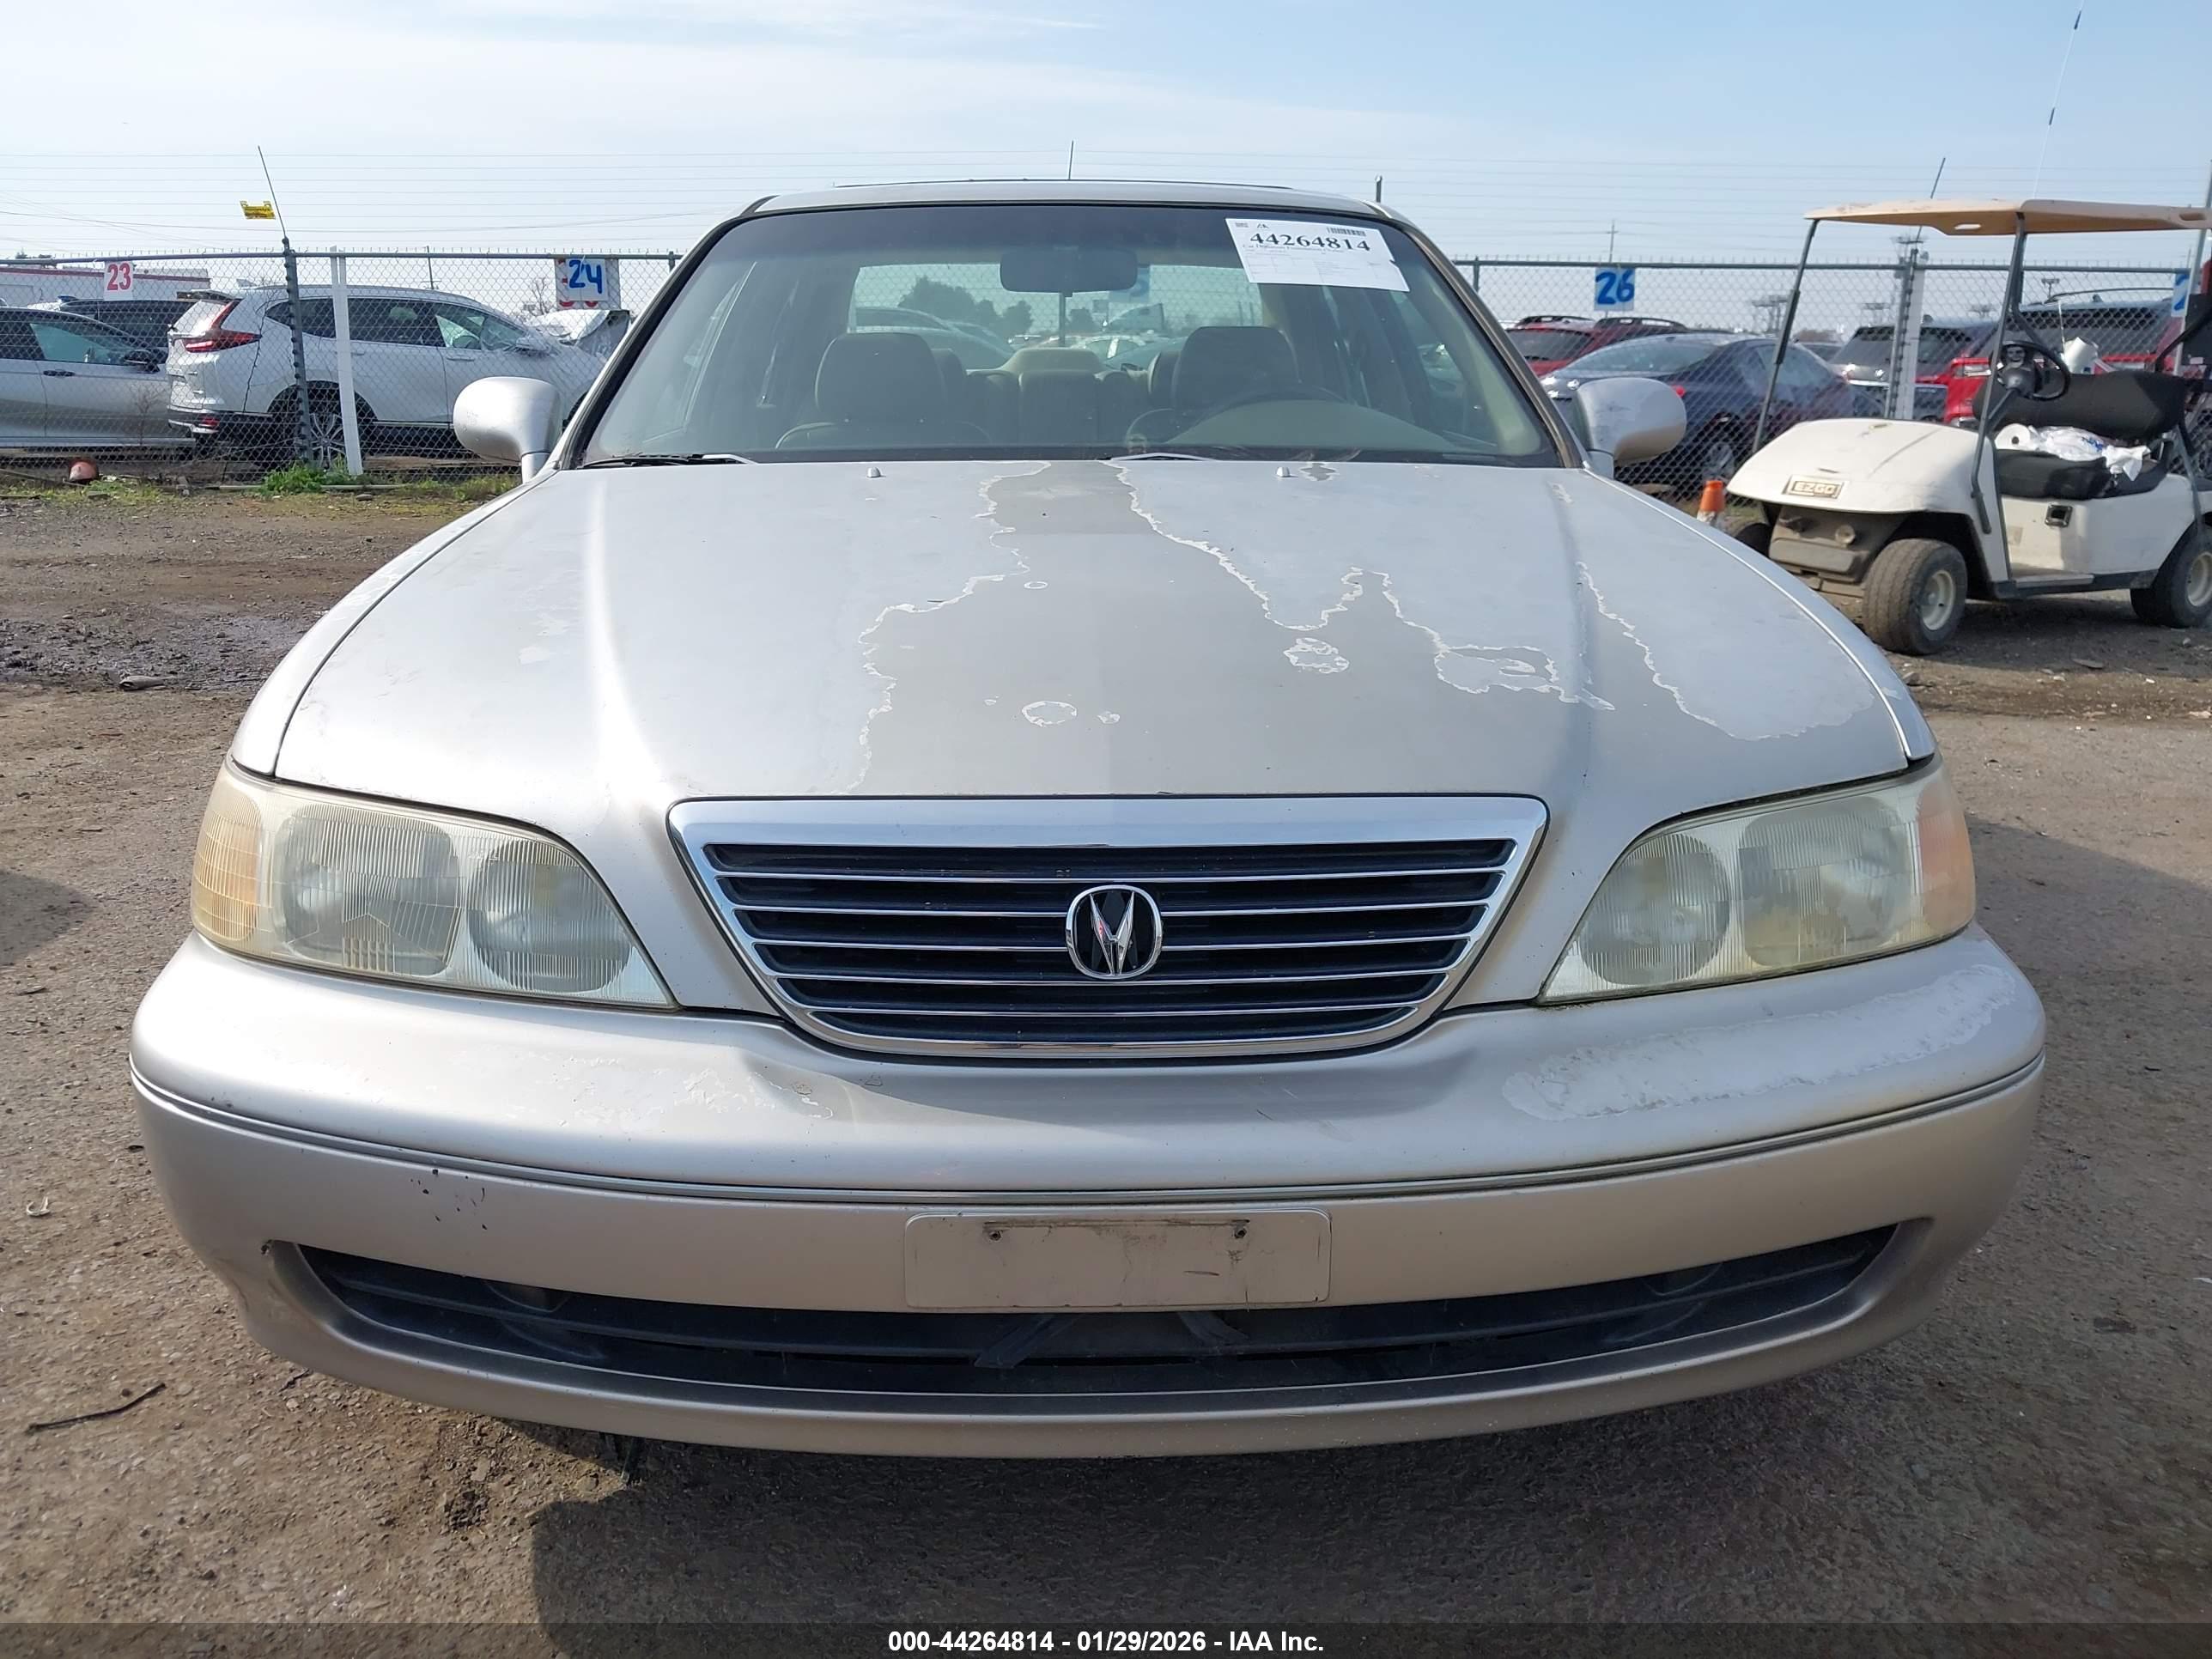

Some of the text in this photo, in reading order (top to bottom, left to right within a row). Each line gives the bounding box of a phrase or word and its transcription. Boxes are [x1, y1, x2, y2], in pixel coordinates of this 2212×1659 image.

[1249, 232, 1370, 252] 44264814
[106, 263, 131, 290] 23
[568, 259, 603, 294] 24
[1595, 269, 1635, 304] 26
